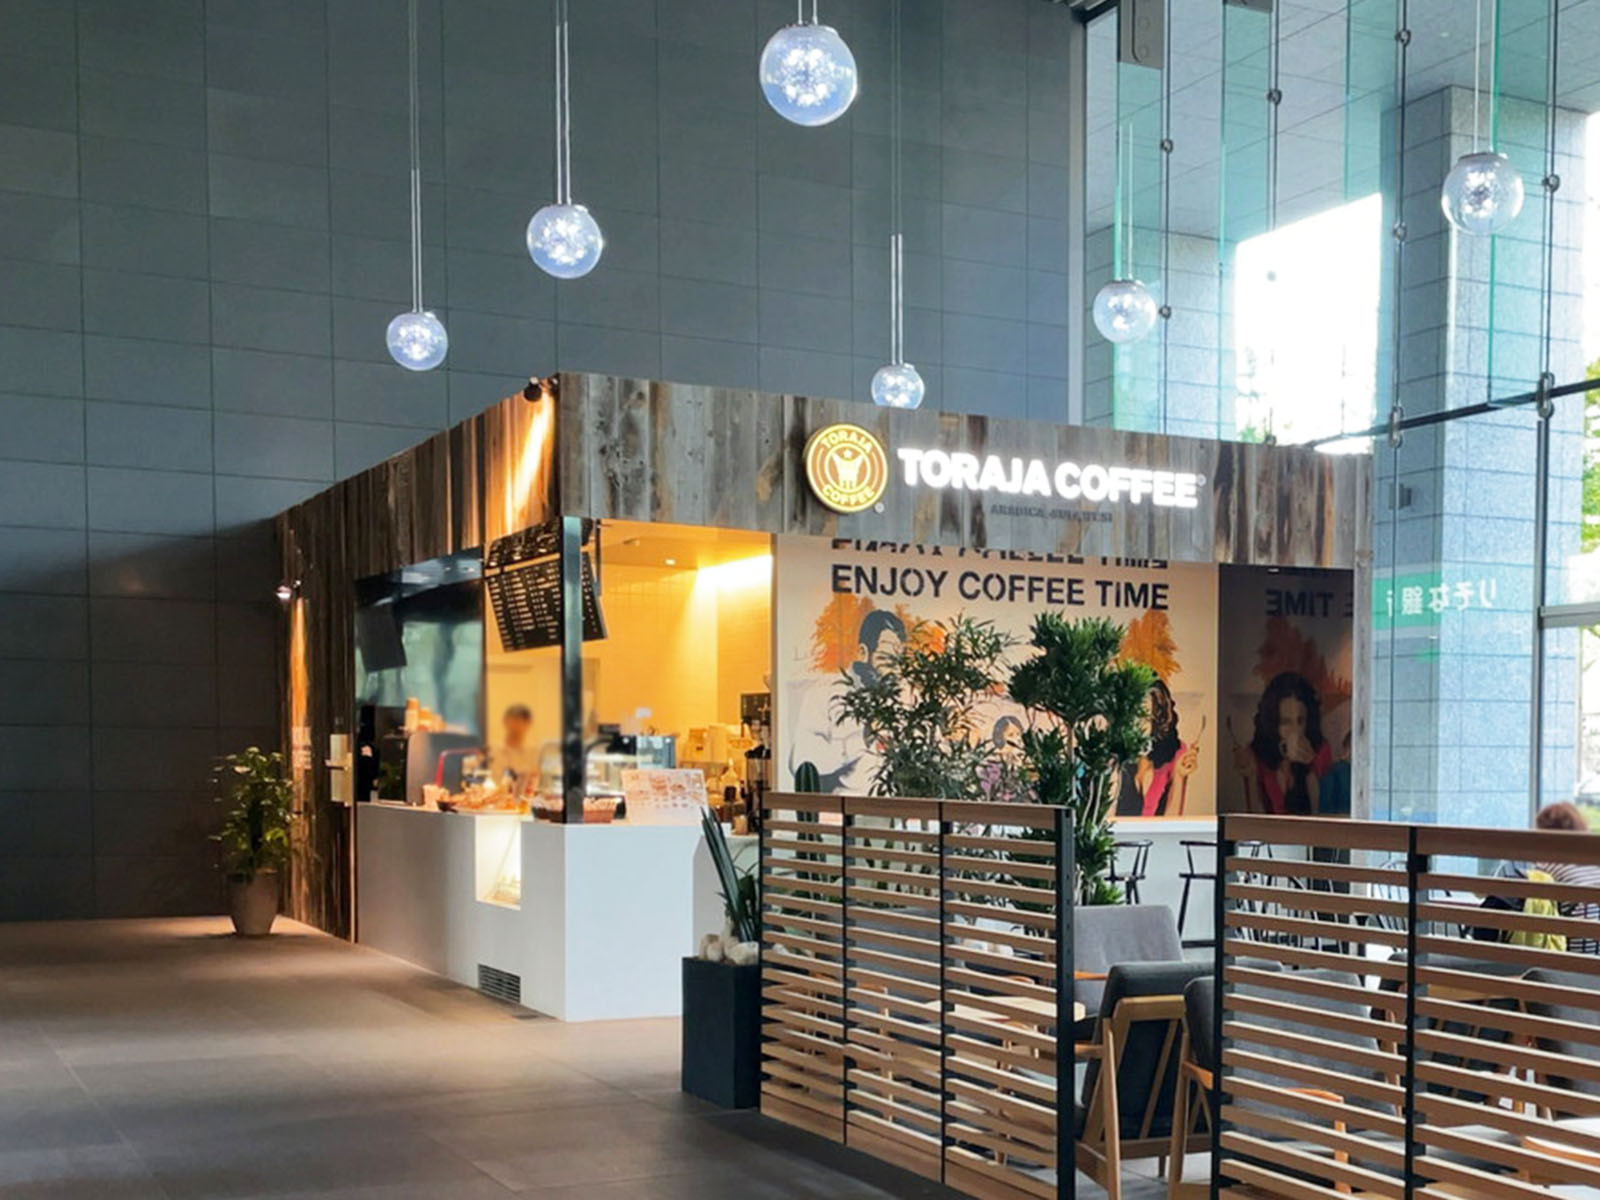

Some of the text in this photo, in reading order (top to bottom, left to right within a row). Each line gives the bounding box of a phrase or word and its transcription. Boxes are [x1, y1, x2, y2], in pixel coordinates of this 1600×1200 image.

[821, 431, 873, 453] TORAJA
[822, 484, 875, 505] COFFEE
[897, 448, 1198, 508] TORAJA COFFEE
[831, 564, 1169, 610] ENJOY COFFEE TIME
